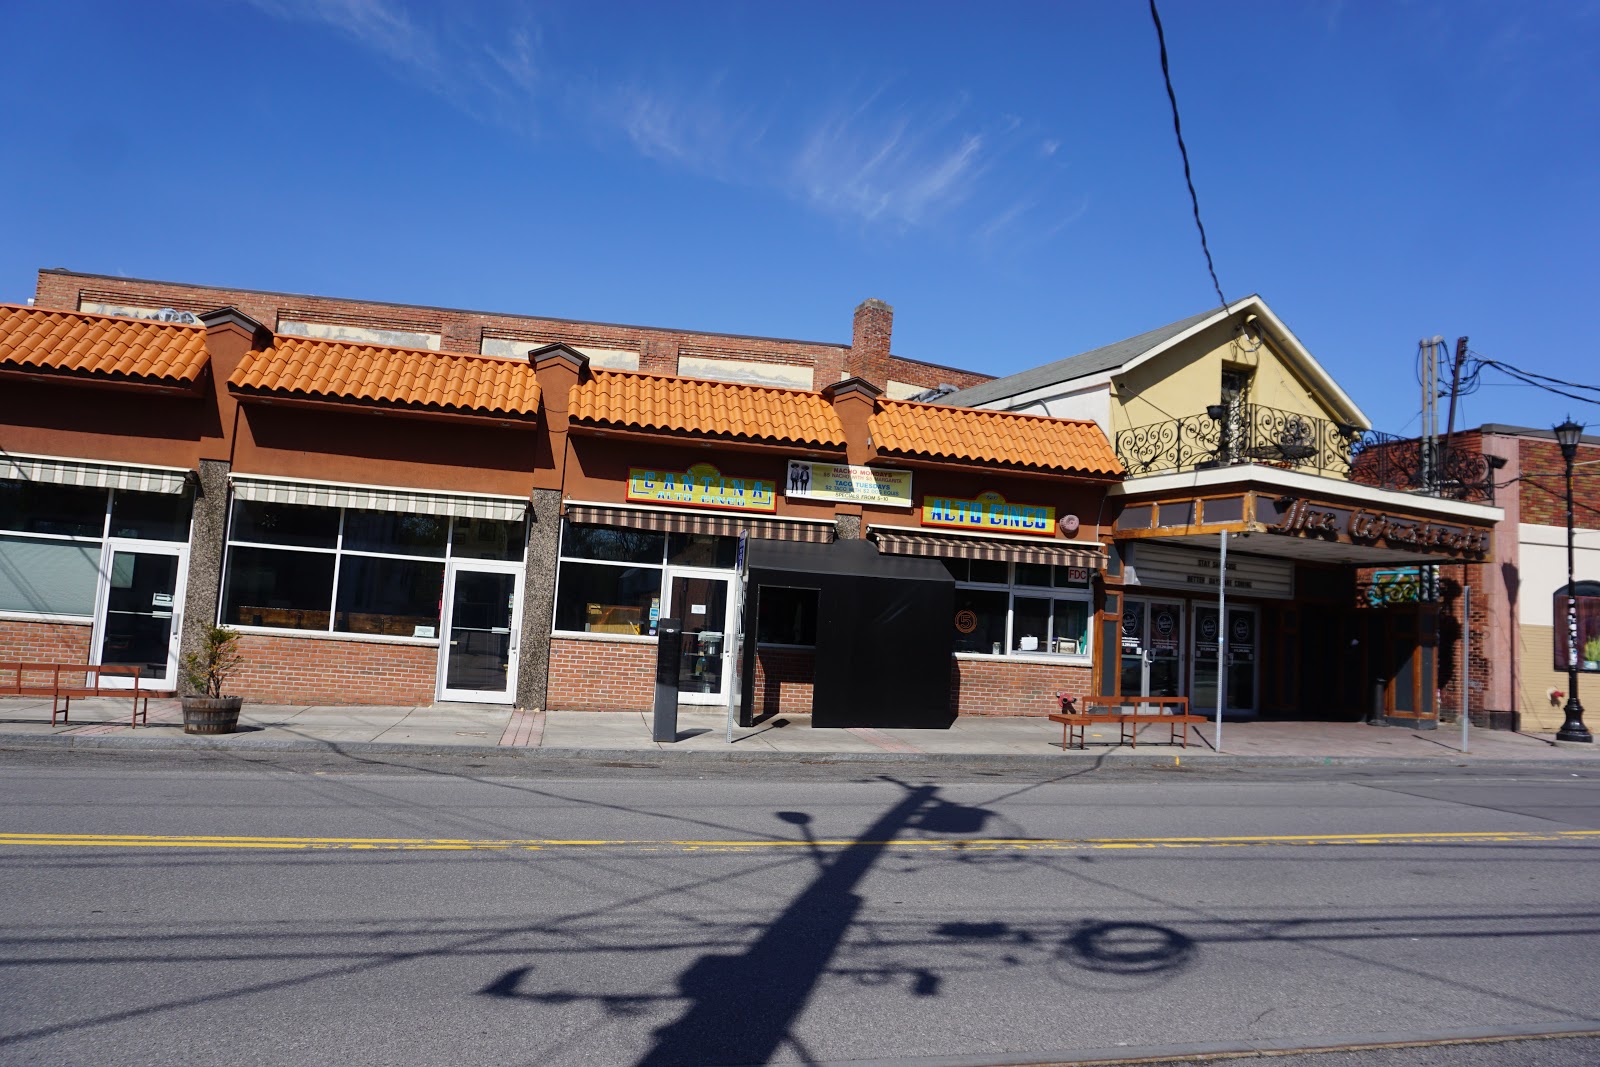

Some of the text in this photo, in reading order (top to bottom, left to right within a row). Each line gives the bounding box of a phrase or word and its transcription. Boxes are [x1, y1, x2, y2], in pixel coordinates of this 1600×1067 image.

[833, 467, 893, 478] NACHO MONDAYS
[644, 471, 763, 498] CANTINA
[855, 482, 891, 490] TUESDAYS
[656, 490, 745, 507] ALTO CINCO
[931, 499, 1047, 530] ALTO CINCO
[1267, 496, 1340, 537] The
[1069, 569, 1087, 580] FDC
[960, 614, 971, 628] 5
